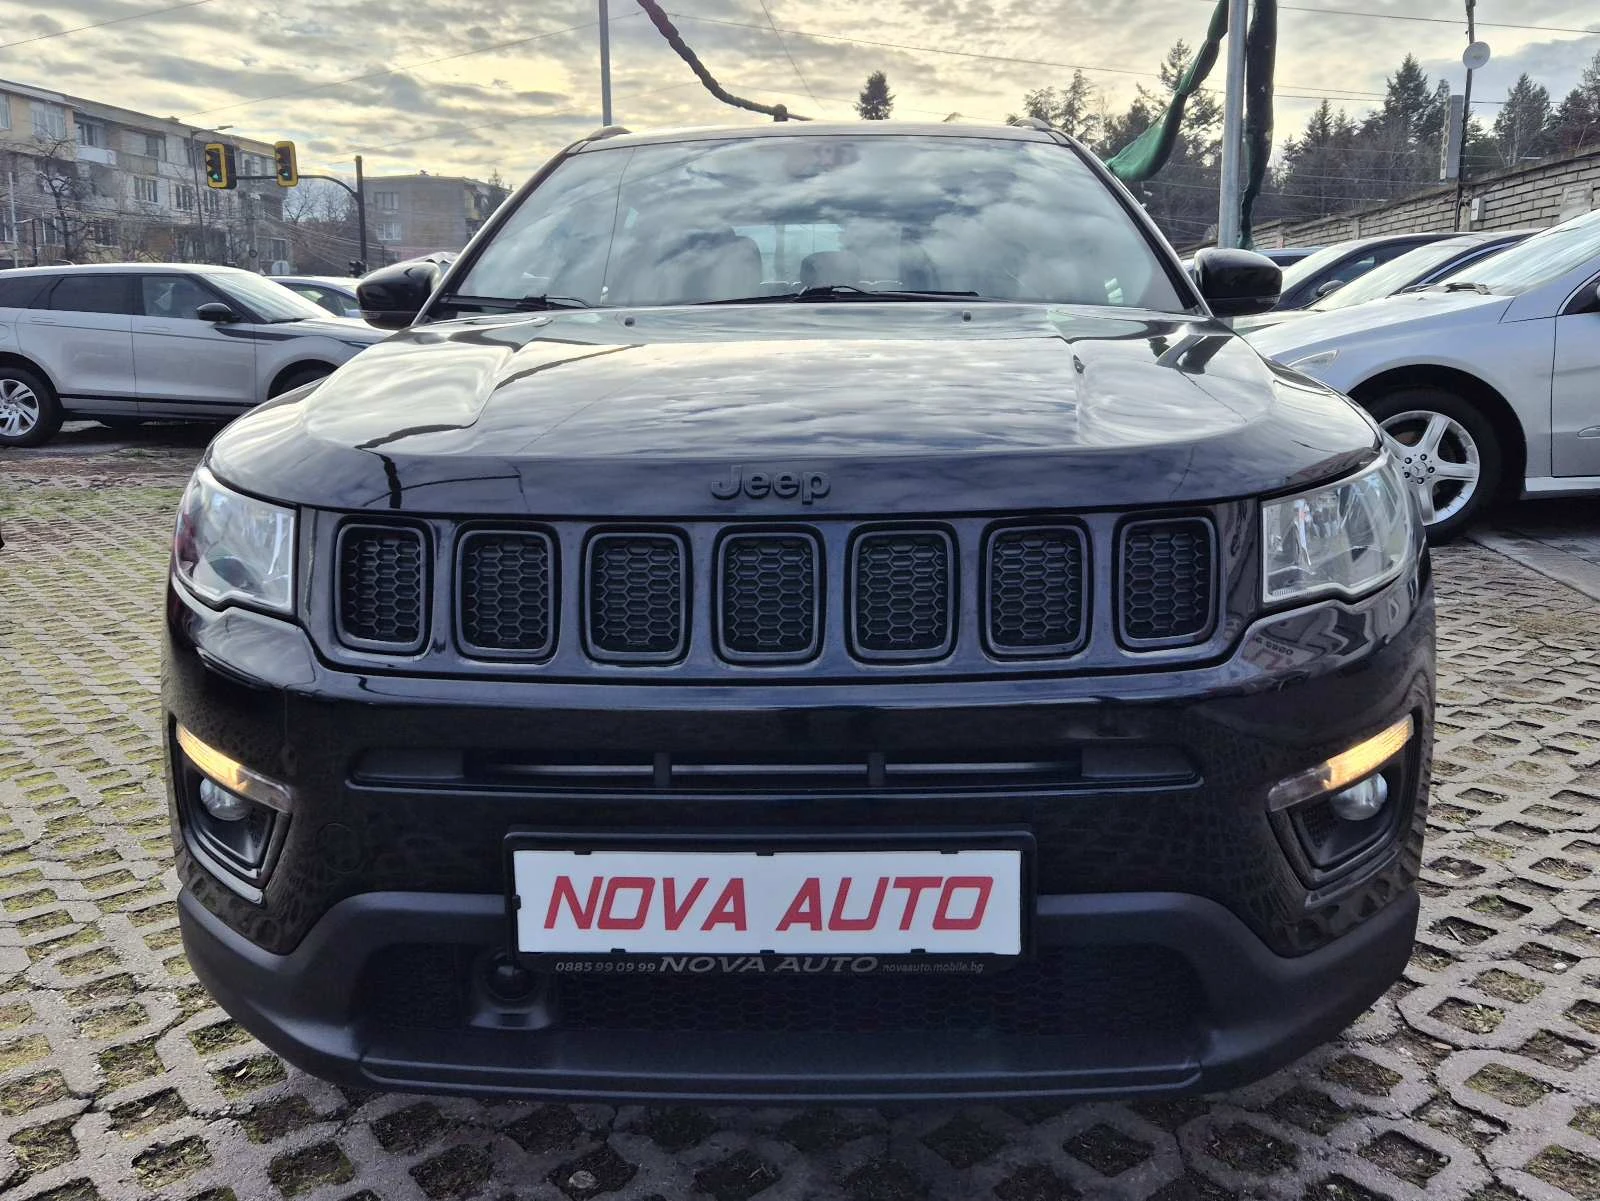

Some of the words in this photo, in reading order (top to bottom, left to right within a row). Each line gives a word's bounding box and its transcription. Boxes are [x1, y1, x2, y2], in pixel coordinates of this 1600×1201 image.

[711, 464, 830, 505] Jeep
[543, 875, 748, 932] NOVA
[775, 876, 994, 932] AUTO
[555, 961, 593, 972] 0885
[596, 962, 613, 972] 99
[616, 962, 635, 972] 09
[638, 962, 656, 972] 99
[659, 956, 766, 972] NOVA
[774, 956, 879, 972] AUTO
[882, 961, 985, 974] novaauto.mobile.bg
